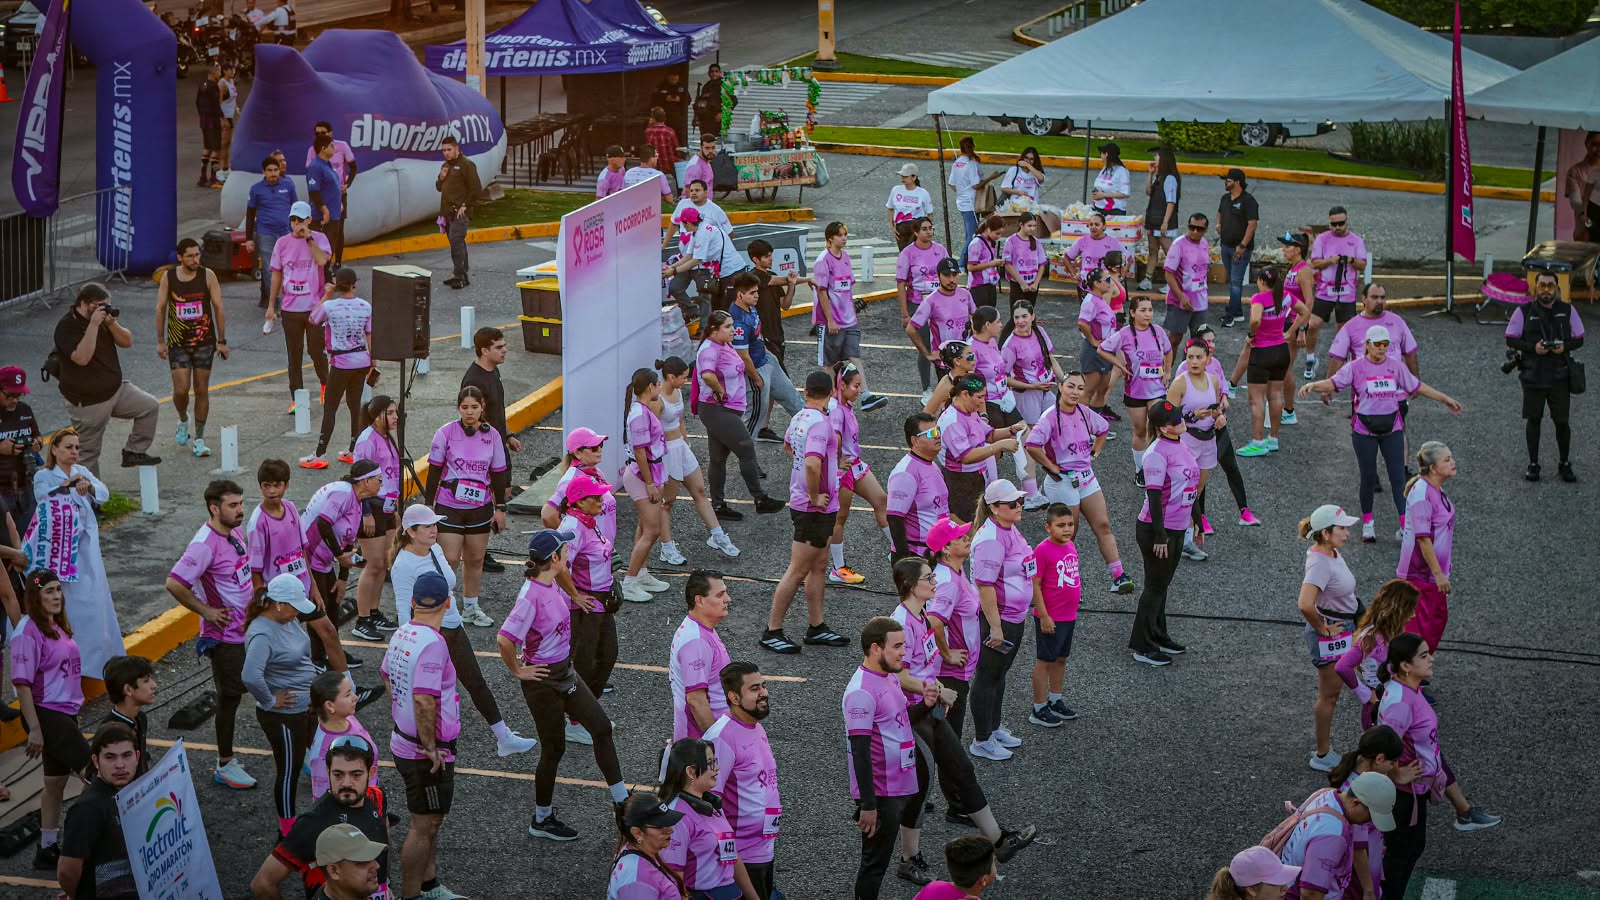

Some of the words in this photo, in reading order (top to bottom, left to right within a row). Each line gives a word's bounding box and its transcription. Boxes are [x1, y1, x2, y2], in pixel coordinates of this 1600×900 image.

[442, 48, 607, 70] dprtenis.mx
[350, 113, 494, 151] dportens.mx
[111, 61, 134, 251] dportenis.mx
[615, 220, 623, 236] YO
[623, 211, 641, 232] CORRO
[583, 225, 605, 254] ROSA
[464, 487, 480, 497] 735
[37, 502, 47, 542] PRUEBA
[36, 544, 46, 557] DE
[1328, 639, 1347, 652] 699
